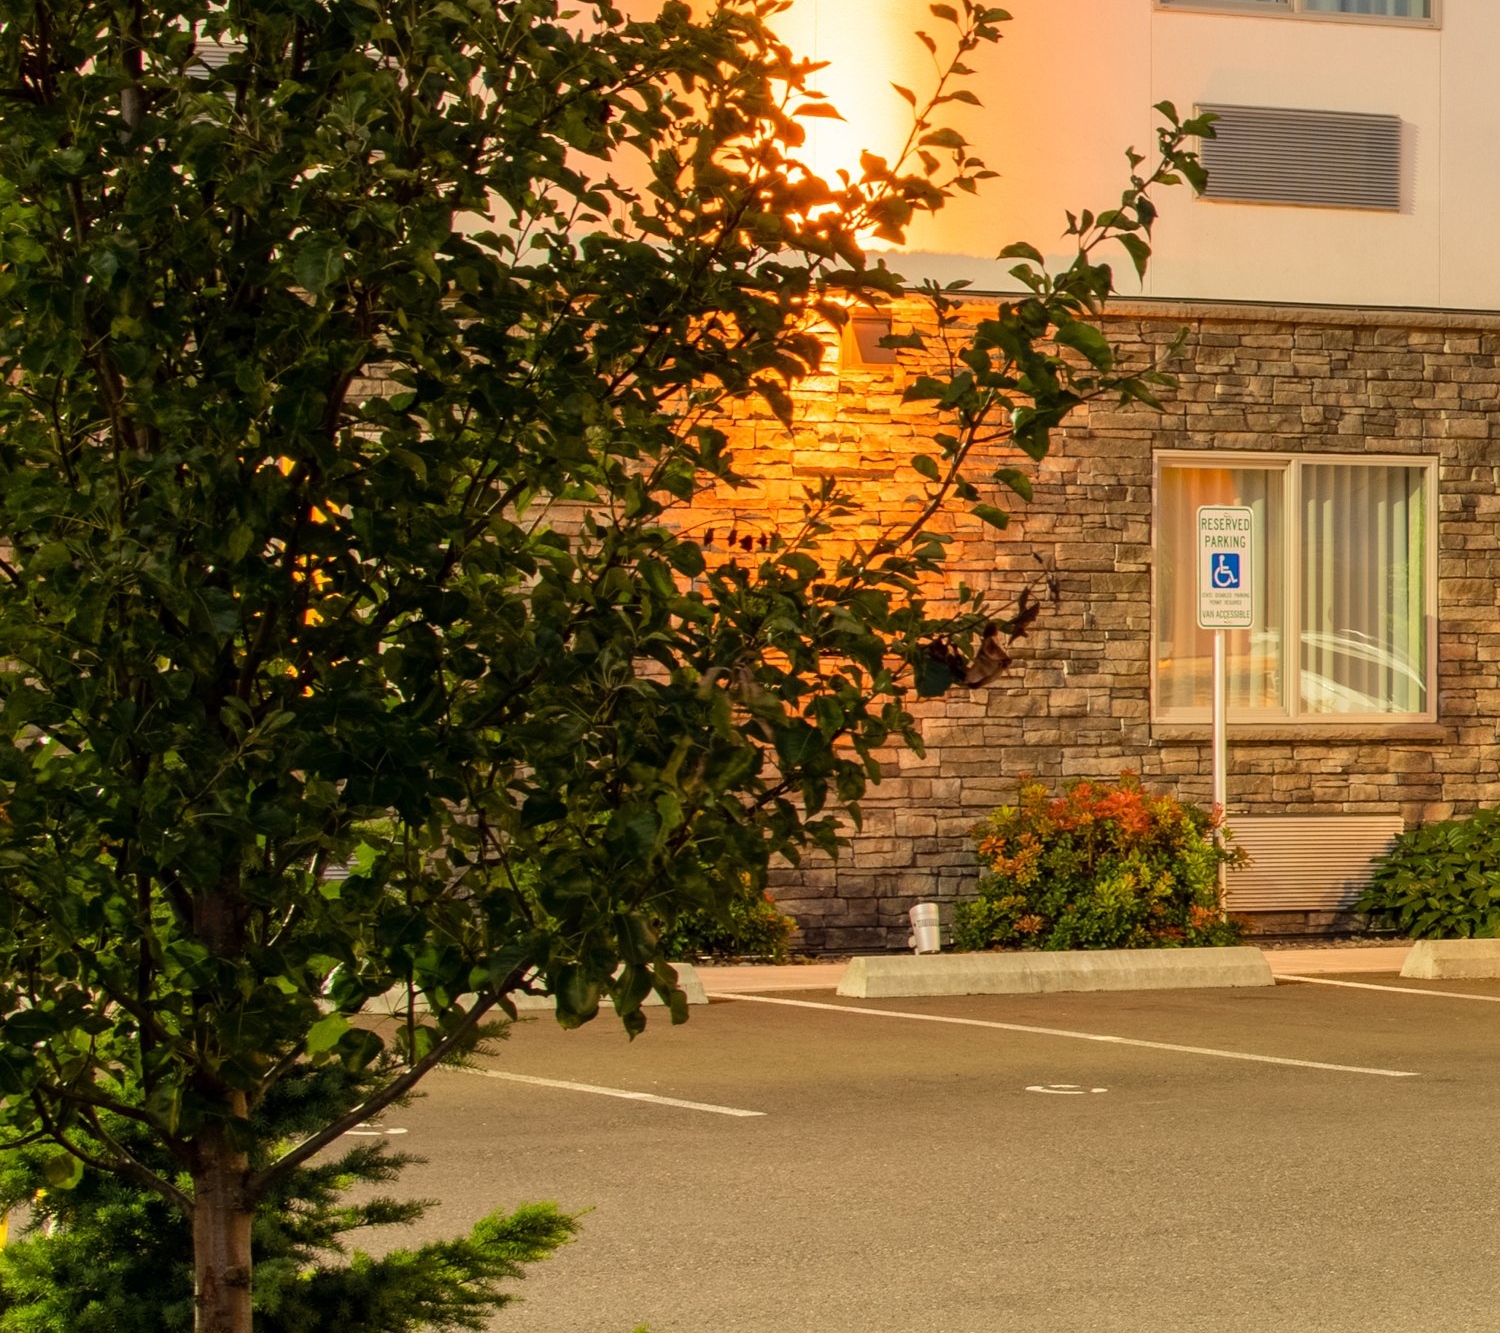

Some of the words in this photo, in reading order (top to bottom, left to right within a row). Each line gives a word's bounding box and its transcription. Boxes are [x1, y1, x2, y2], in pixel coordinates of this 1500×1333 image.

[1201, 518, 1250, 531] RESERVED
[1205, 535, 1246, 548] PARKING
[1202, 610, 1214, 619] VAN
[1216, 610, 1250, 619] ACCESSIBLE
